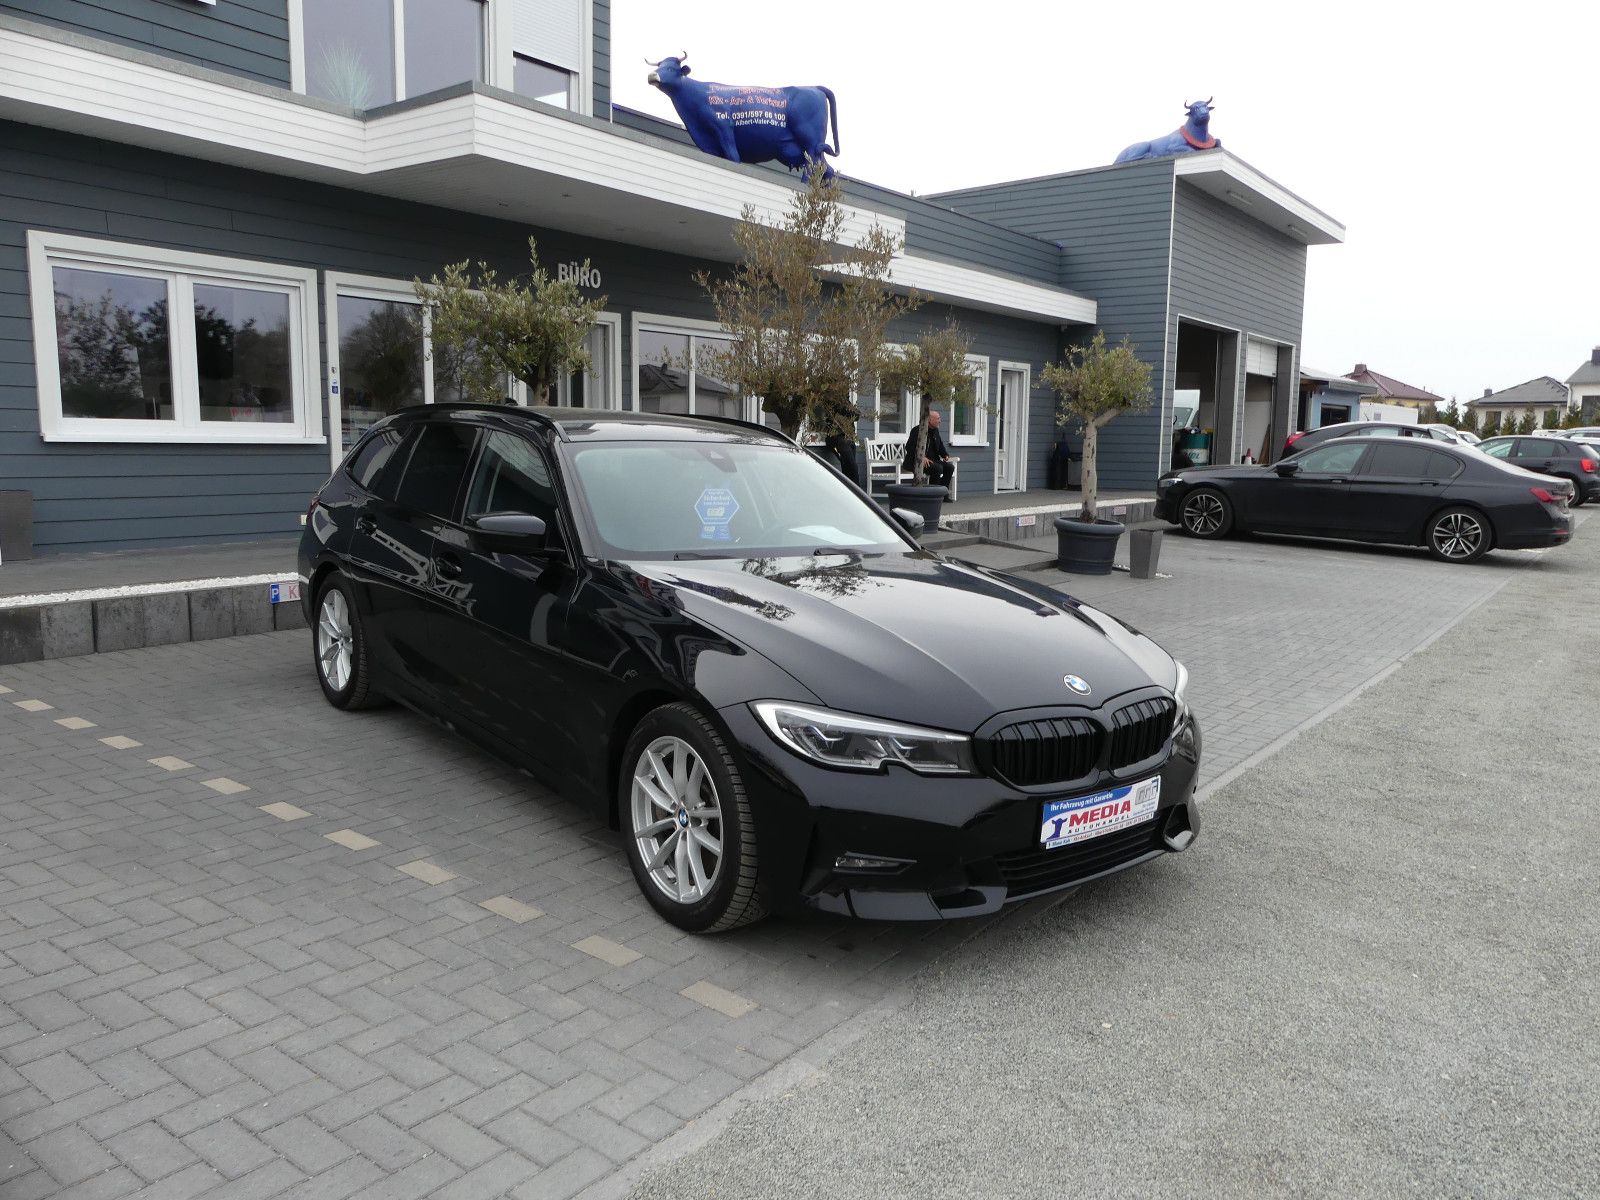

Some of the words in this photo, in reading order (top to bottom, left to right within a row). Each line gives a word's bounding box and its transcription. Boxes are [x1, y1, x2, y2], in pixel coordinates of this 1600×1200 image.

[716, 112, 730, 120] Tel.
[732, 110, 762, 120] 0391/597
[774, 113, 786, 121] 100
[558, 261, 601, 288] BÜRO
[272, 588, 279, 599] P
[1050, 804, 1059, 812] Ihr
[1059, 800, 1085, 810] Fahrzeug
[1085, 797, 1094, 805] mit
[1094, 792, 1114, 803] Garantie
[1068, 800, 1131, 827] MEDIA
[1067, 814, 1130, 834] AUTOHANDEL
